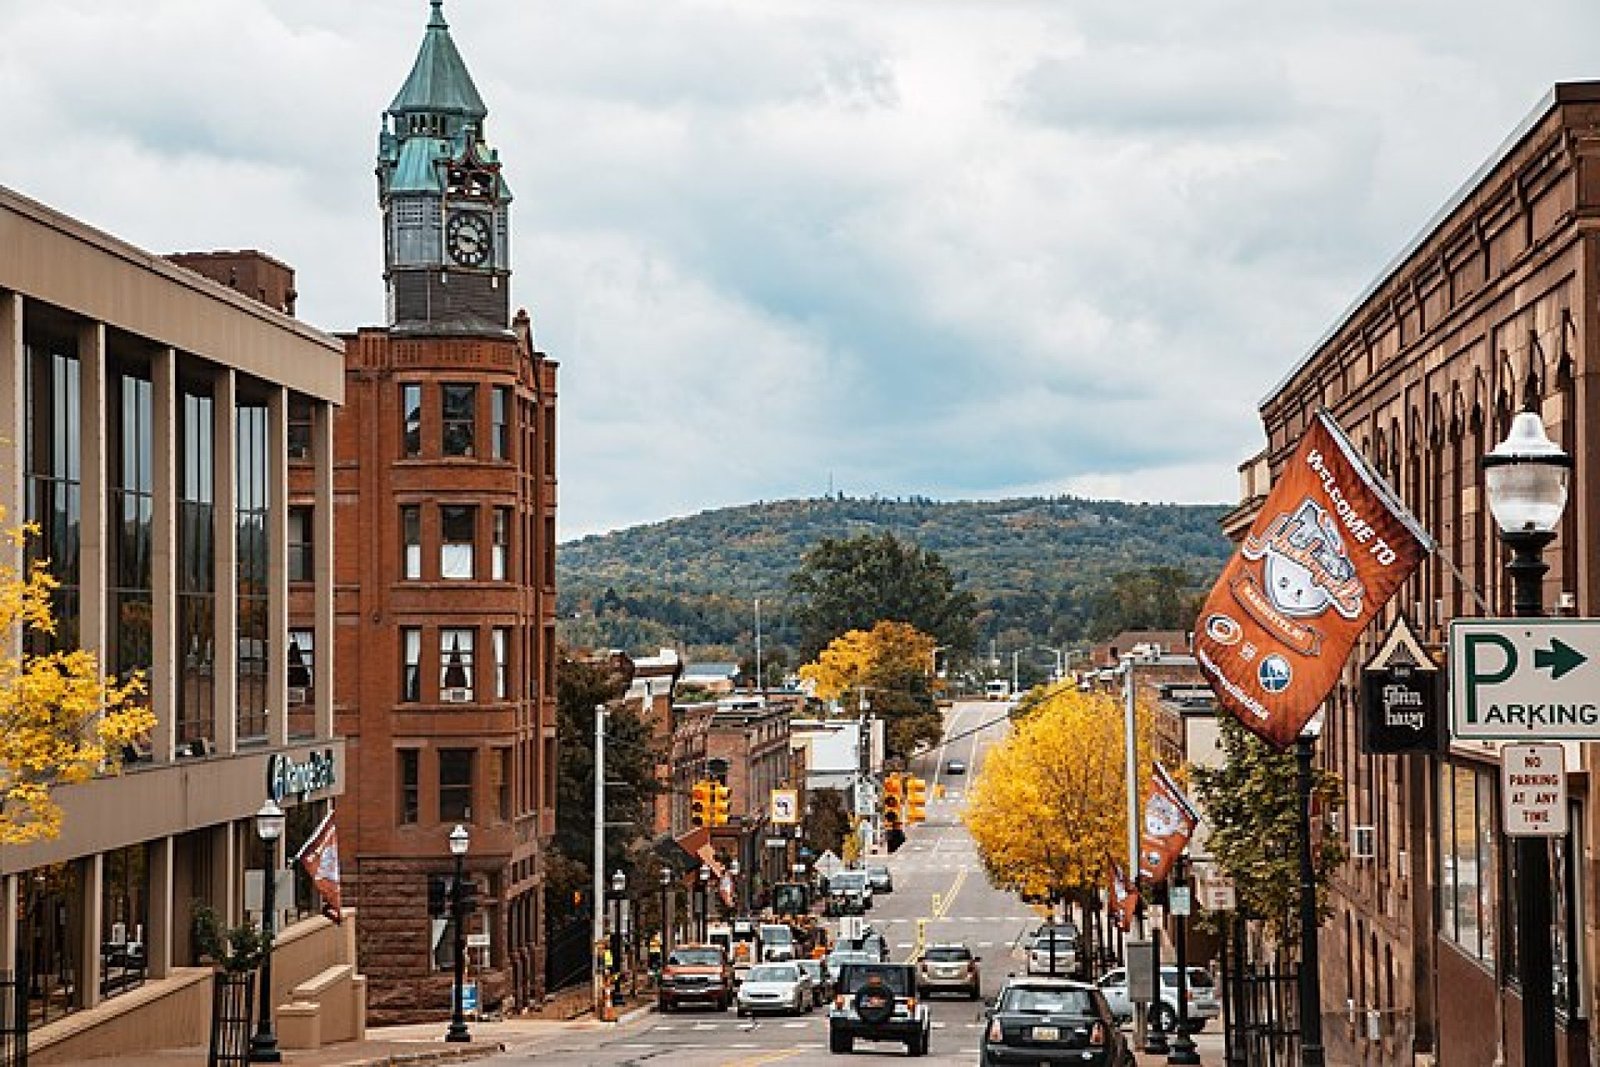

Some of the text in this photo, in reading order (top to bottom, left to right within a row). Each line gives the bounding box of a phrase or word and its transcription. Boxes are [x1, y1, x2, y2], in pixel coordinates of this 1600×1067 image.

[1307, 449, 1396, 566] WELCOME TO
[1465, 634, 1599, 725] PARKING
[1524, 756, 1542, 768] NO
[1509, 774, 1559, 787] PARKING
[1512, 792, 1559, 804] AT ANY
[1522, 809, 1550, 823] TIME
